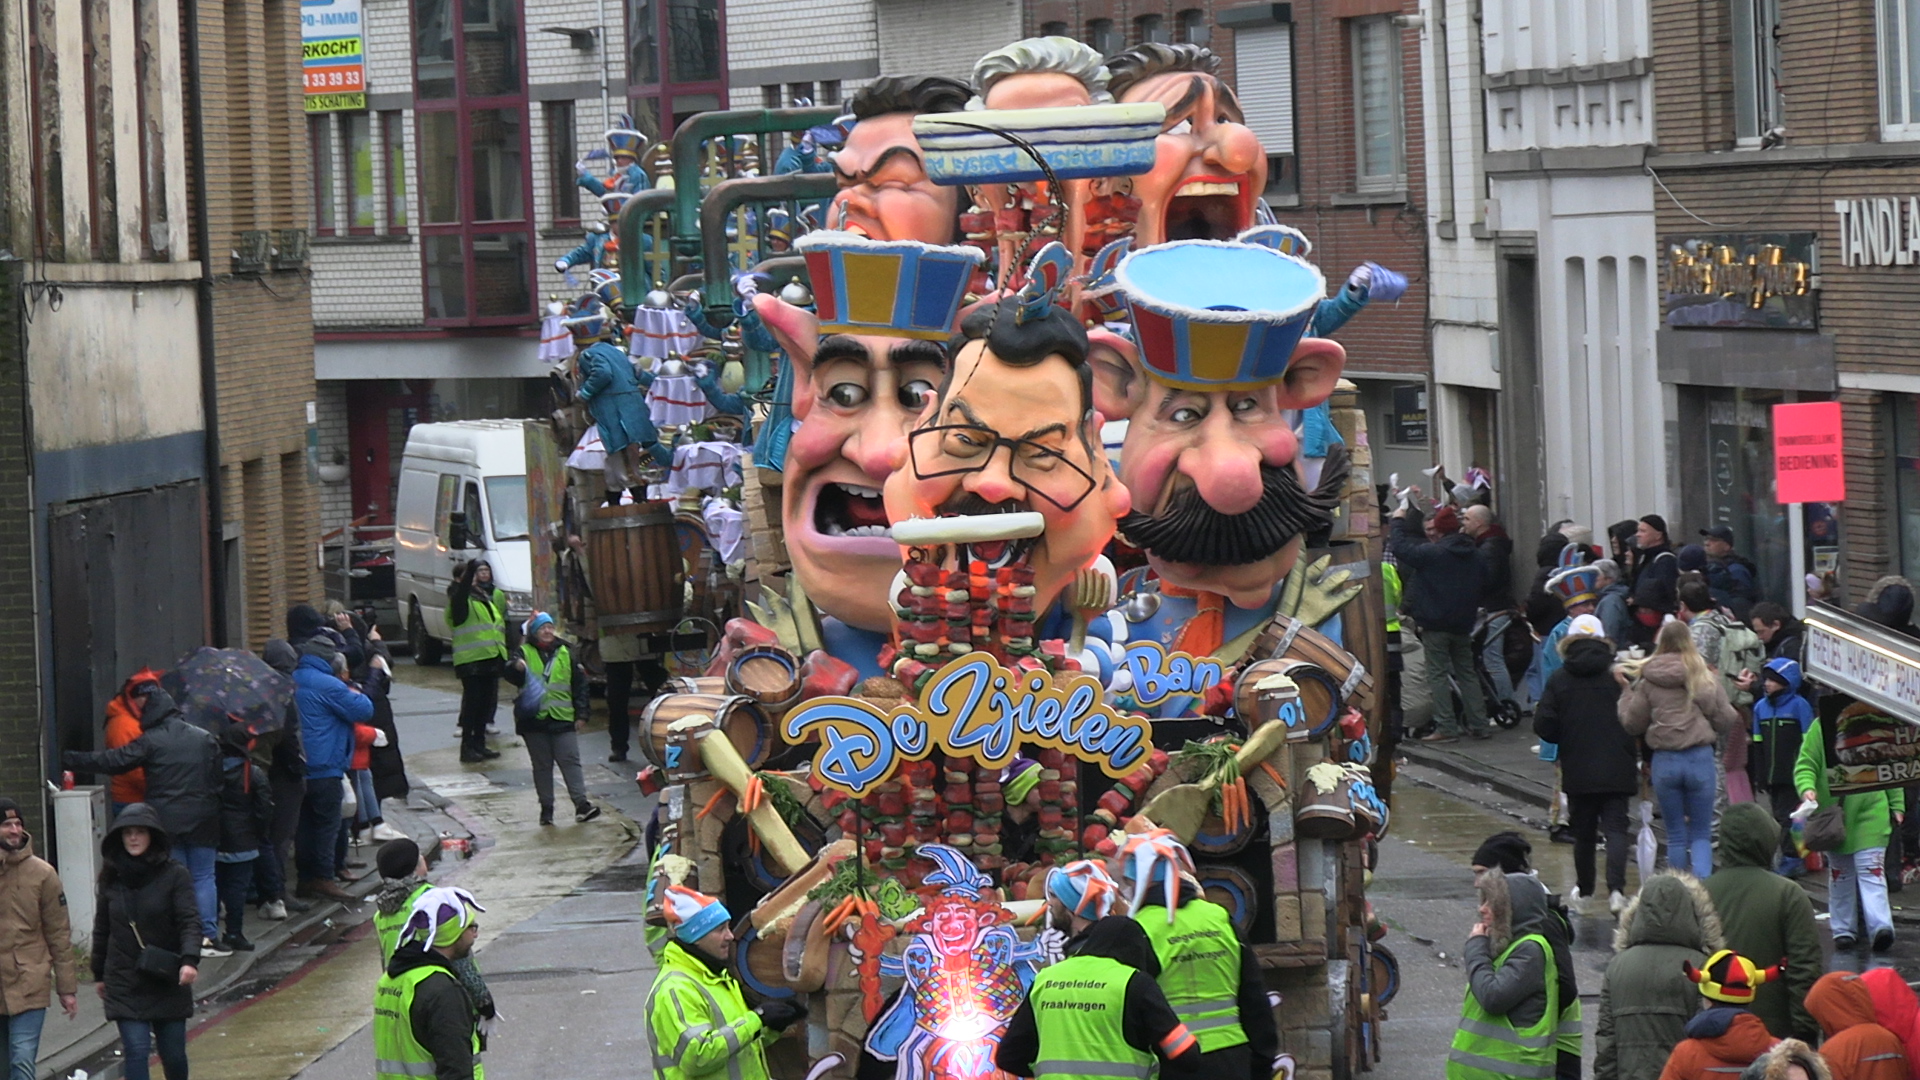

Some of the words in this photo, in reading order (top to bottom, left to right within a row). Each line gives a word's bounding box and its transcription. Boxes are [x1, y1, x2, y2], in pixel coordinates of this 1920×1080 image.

[312, 73, 326, 87] 33
[329, 72, 343, 86] 39
[346, 71, 360, 85] 33
[1779, 454, 1838, 471] BEDIENING
[1118, 645, 1221, 704] Ban
[788, 704, 927, 792] De
[929, 660, 1144, 769] Zjielen
[1045, 979, 1107, 990] Begeleider
